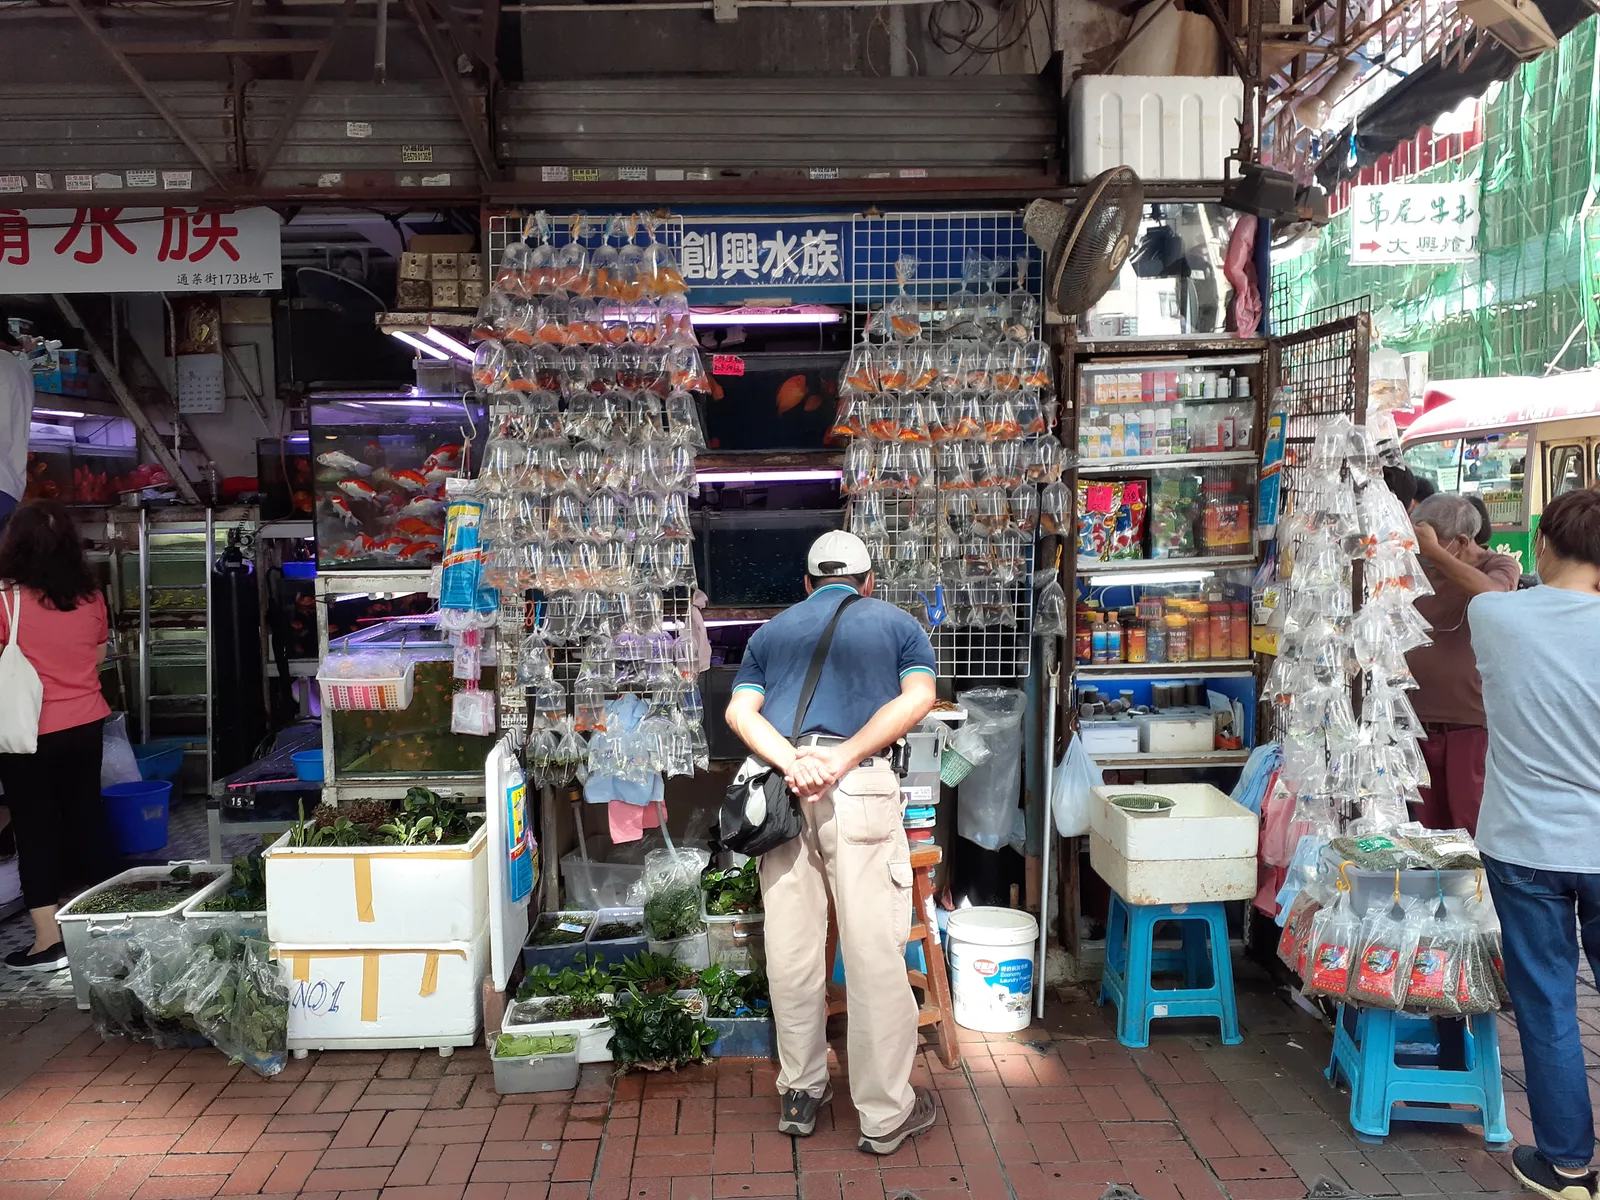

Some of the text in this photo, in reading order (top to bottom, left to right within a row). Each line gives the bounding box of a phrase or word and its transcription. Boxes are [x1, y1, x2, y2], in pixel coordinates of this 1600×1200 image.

[683, 229, 839, 280] 創興水族
[176, 272, 274, 286] 通菜街173B地下
[1517, 404, 1556, 421] LIGHT
[231, 797, 242, 806] 15
